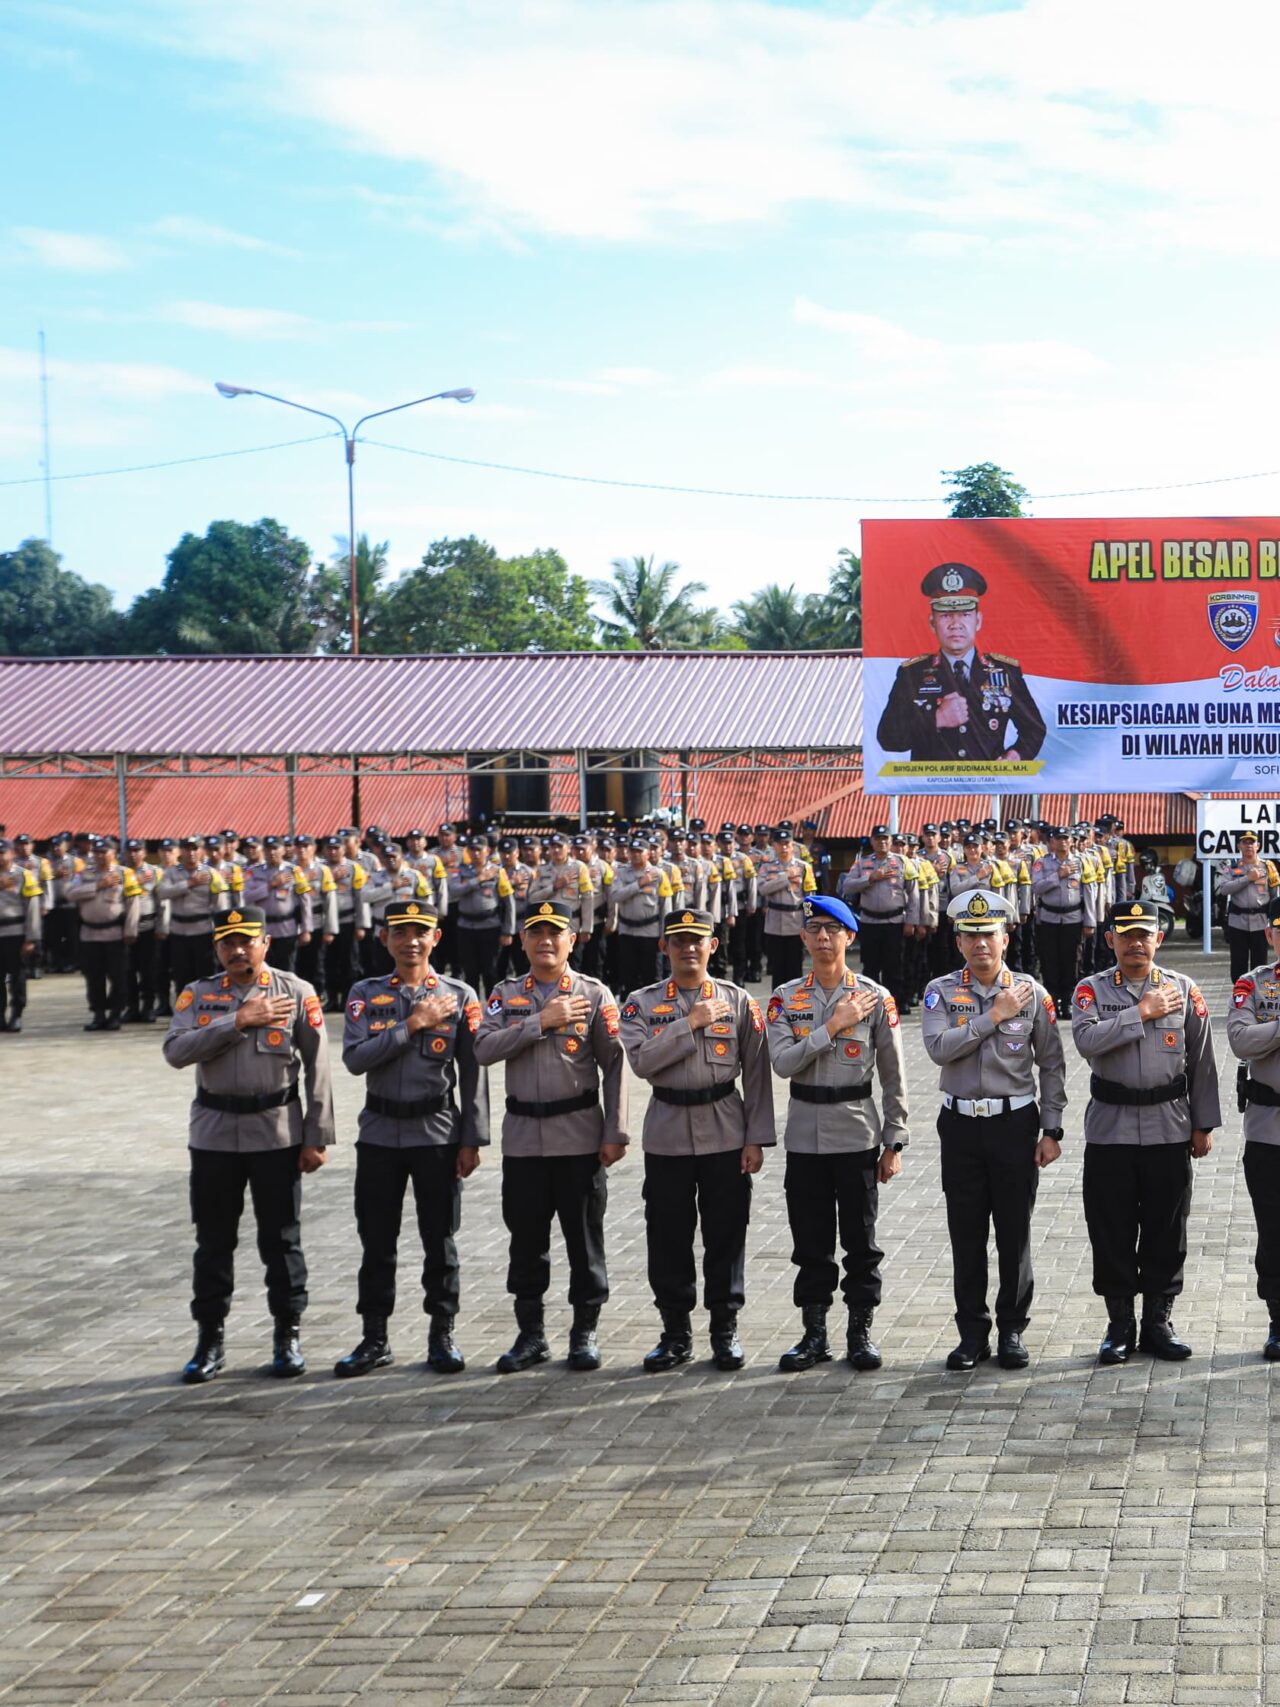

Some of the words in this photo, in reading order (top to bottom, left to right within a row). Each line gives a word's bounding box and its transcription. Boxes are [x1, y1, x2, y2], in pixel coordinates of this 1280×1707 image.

[1090, 541, 1155, 580] APEL
[1163, 540, 1250, 579] BESAR
[1057, 703, 1199, 725] KESIAPSIAGAAN
[1204, 702, 1253, 724] GUNA
[1122, 734, 1140, 756] DI
[1145, 733, 1223, 755] WILAYAH
[370, 1007, 397, 1017] AZIS
[950, 1004, 976, 1013] DONI
